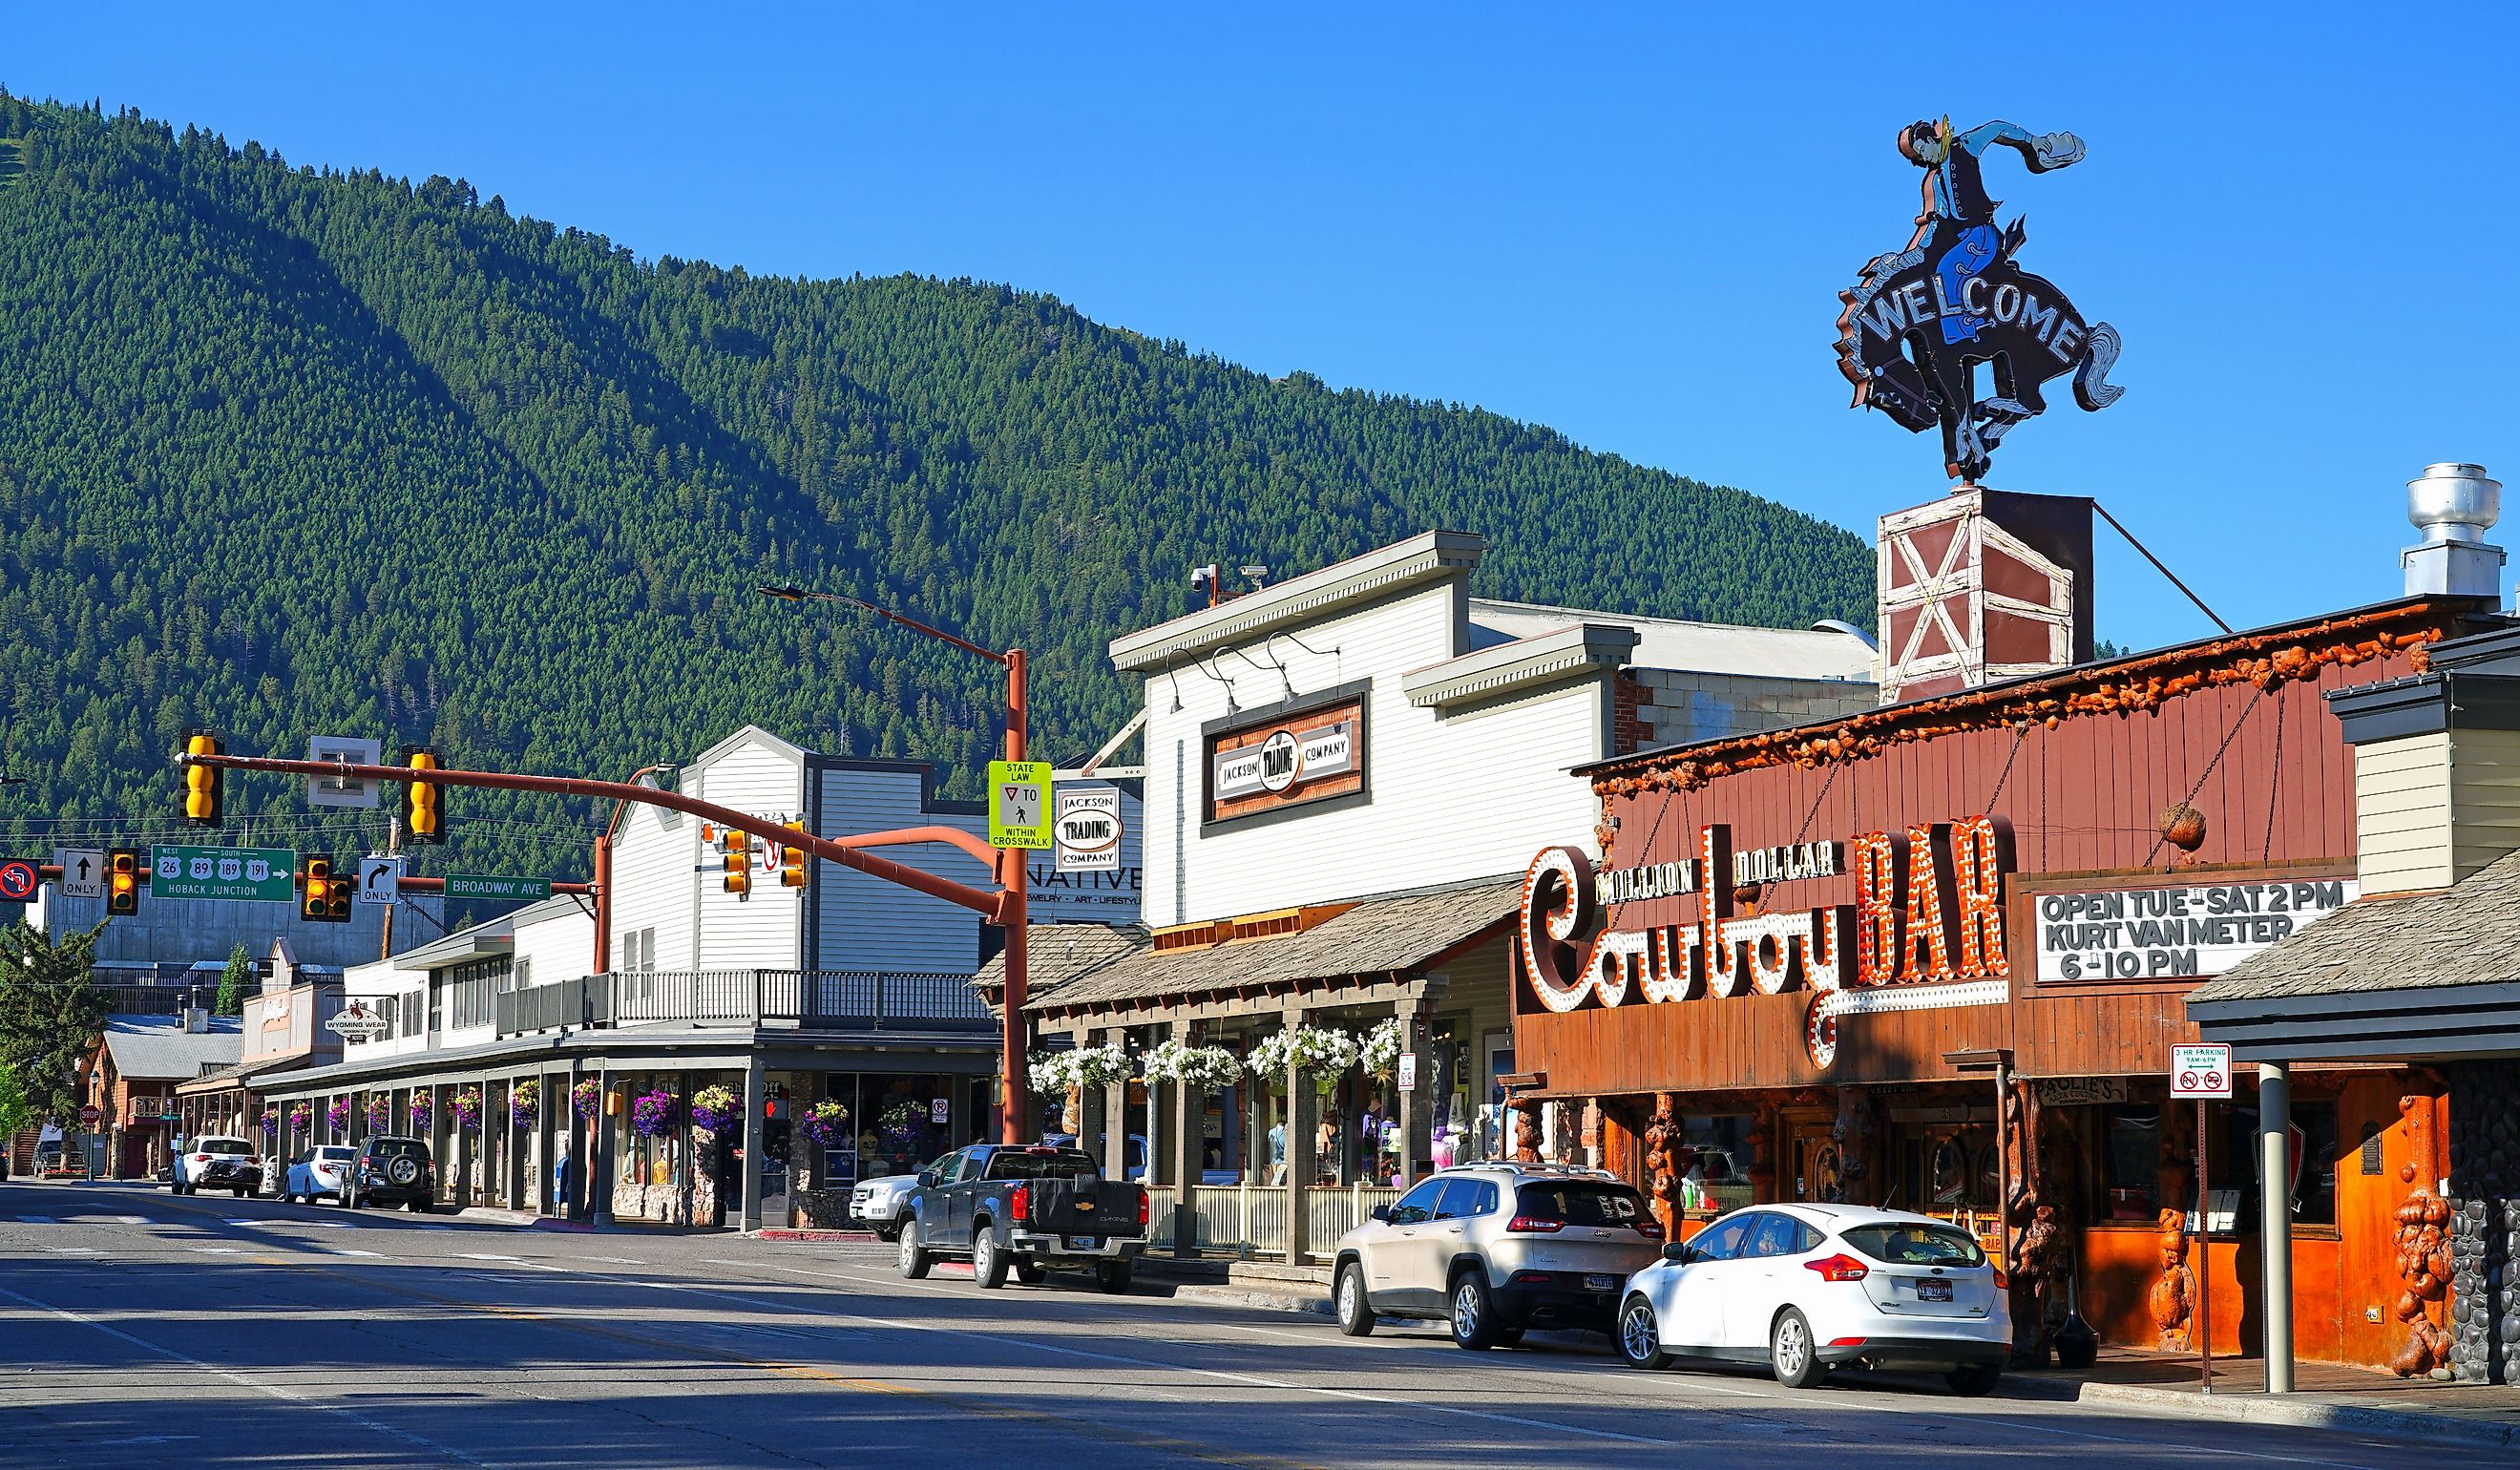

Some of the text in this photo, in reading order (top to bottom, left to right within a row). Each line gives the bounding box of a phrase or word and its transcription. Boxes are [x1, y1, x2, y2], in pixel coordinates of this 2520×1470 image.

[1859, 275, 2088, 365] WELCOME
[1006, 764, 1035, 773] STATE
[1223, 740, 1346, 785] JACKSON TRADING COMPANY
[1011, 773, 1030, 782] LAW
[1023, 789, 1037, 802] TO
[1064, 797, 1114, 809] JACKSON
[1005, 828, 1037, 837] WITHIN
[1062, 820, 1111, 840] TRADING
[993, 836, 1048, 847] CROSSWALK
[1062, 852, 1114, 864] COMPANY
[162, 861, 264, 876] 26 89 189 191
[1594, 839, 1835, 906] MILLION DOLLAR
[67, 884, 96, 894] ONLY
[168, 884, 258, 895] HOBACK JUNCTION
[452, 880, 543, 895] BROADWAY AVE
[365, 891, 392, 901] ONLY
[1027, 894, 1061, 903] EWELRY
[2042, 892, 2124, 922] OPEN
[2129, 885, 2264, 918] TUE-SAT
[2046, 914, 2294, 952] KURT VAN METER
[1522, 814, 2009, 1069] Cowboy BAR
[2061, 948, 2198, 979] 6-10 PM
